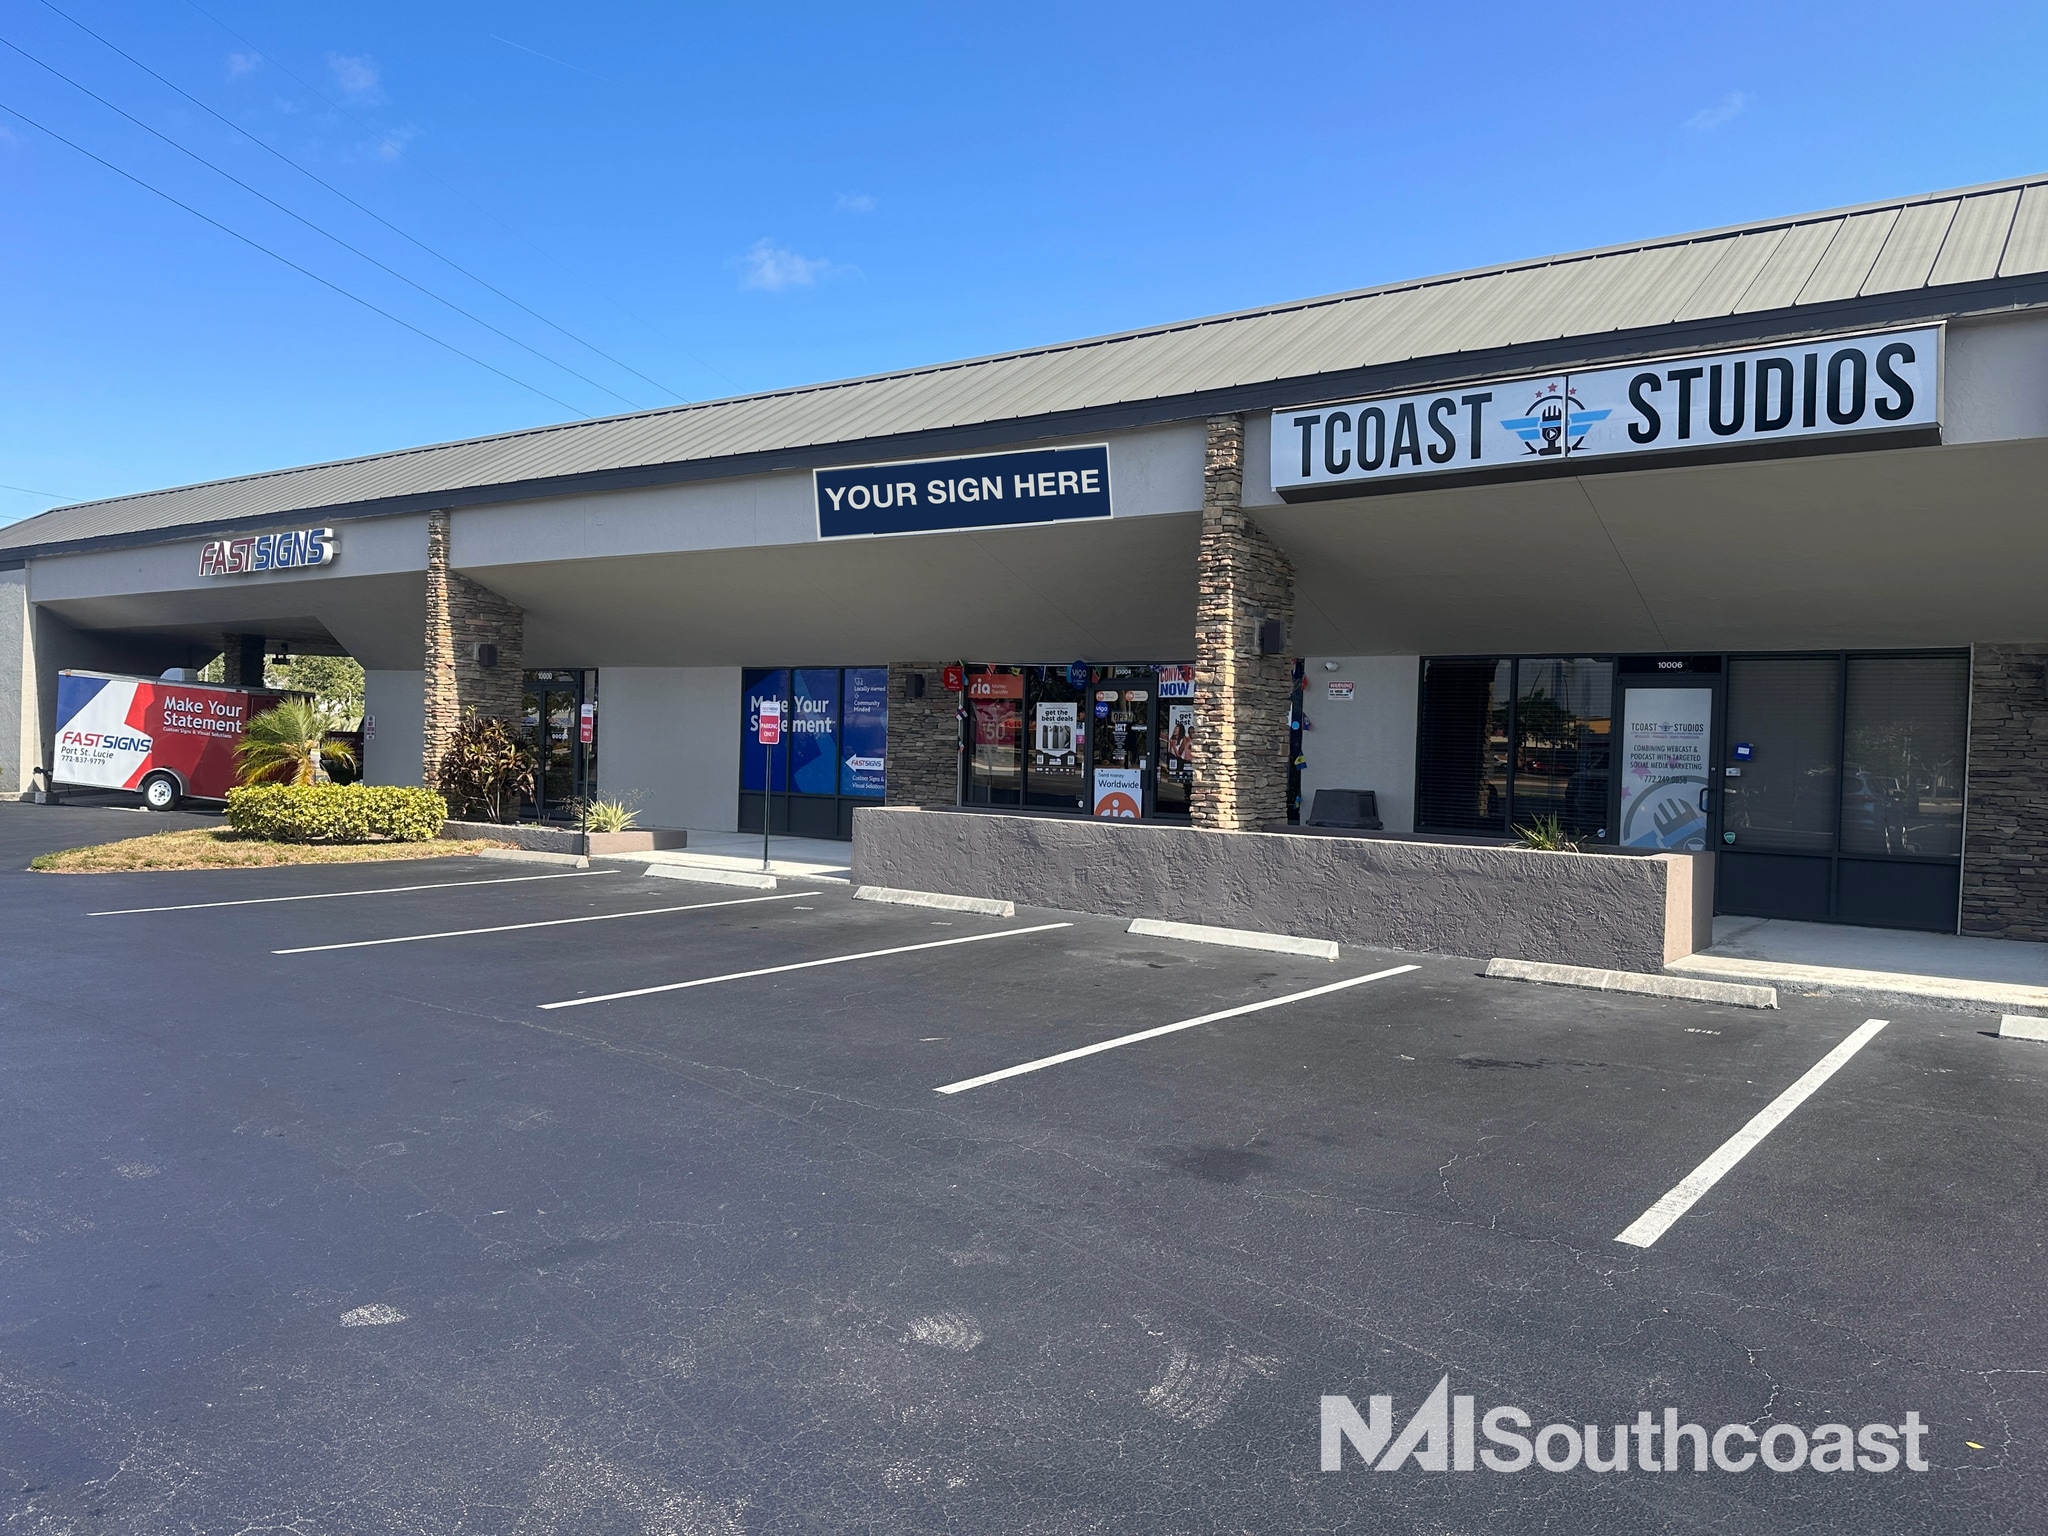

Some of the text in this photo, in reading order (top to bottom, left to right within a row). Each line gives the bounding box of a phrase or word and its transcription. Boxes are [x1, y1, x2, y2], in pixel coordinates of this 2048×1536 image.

[1293, 342, 1915, 477] TCOAST STUDIOS
[825, 469, 1101, 511] YOUR SIGN HERE
[199, 528, 331, 577] FASTSIGNS
[1658, 661, 1683, 669] 10006
[970, 678, 991, 694] ria
[1160, 683, 1190, 696] NOW
[164, 696, 242, 717] Make Your
[793, 696, 829, 713] Your
[854, 700, 881, 708] Community
[163, 711, 242, 733] Statement
[1179, 713, 1192, 721] get
[1631, 723, 1704, 732] TCOAST STUDIOS
[62, 731, 151, 753] FASTSIGNS
[61, 746, 114, 759] Port St. Lucie
[1667, 745, 1692, 753] WEBCAST
[61, 755, 106, 765] 772-837-9779
[1631, 753, 1656, 761] PODCAST
[1671, 754, 1701, 762] TARGETED
[1630, 761, 1649, 769] SOCIAL
[1669, 762, 1702, 770] MARKETING
[1098, 780, 1139, 789] Worldwide
